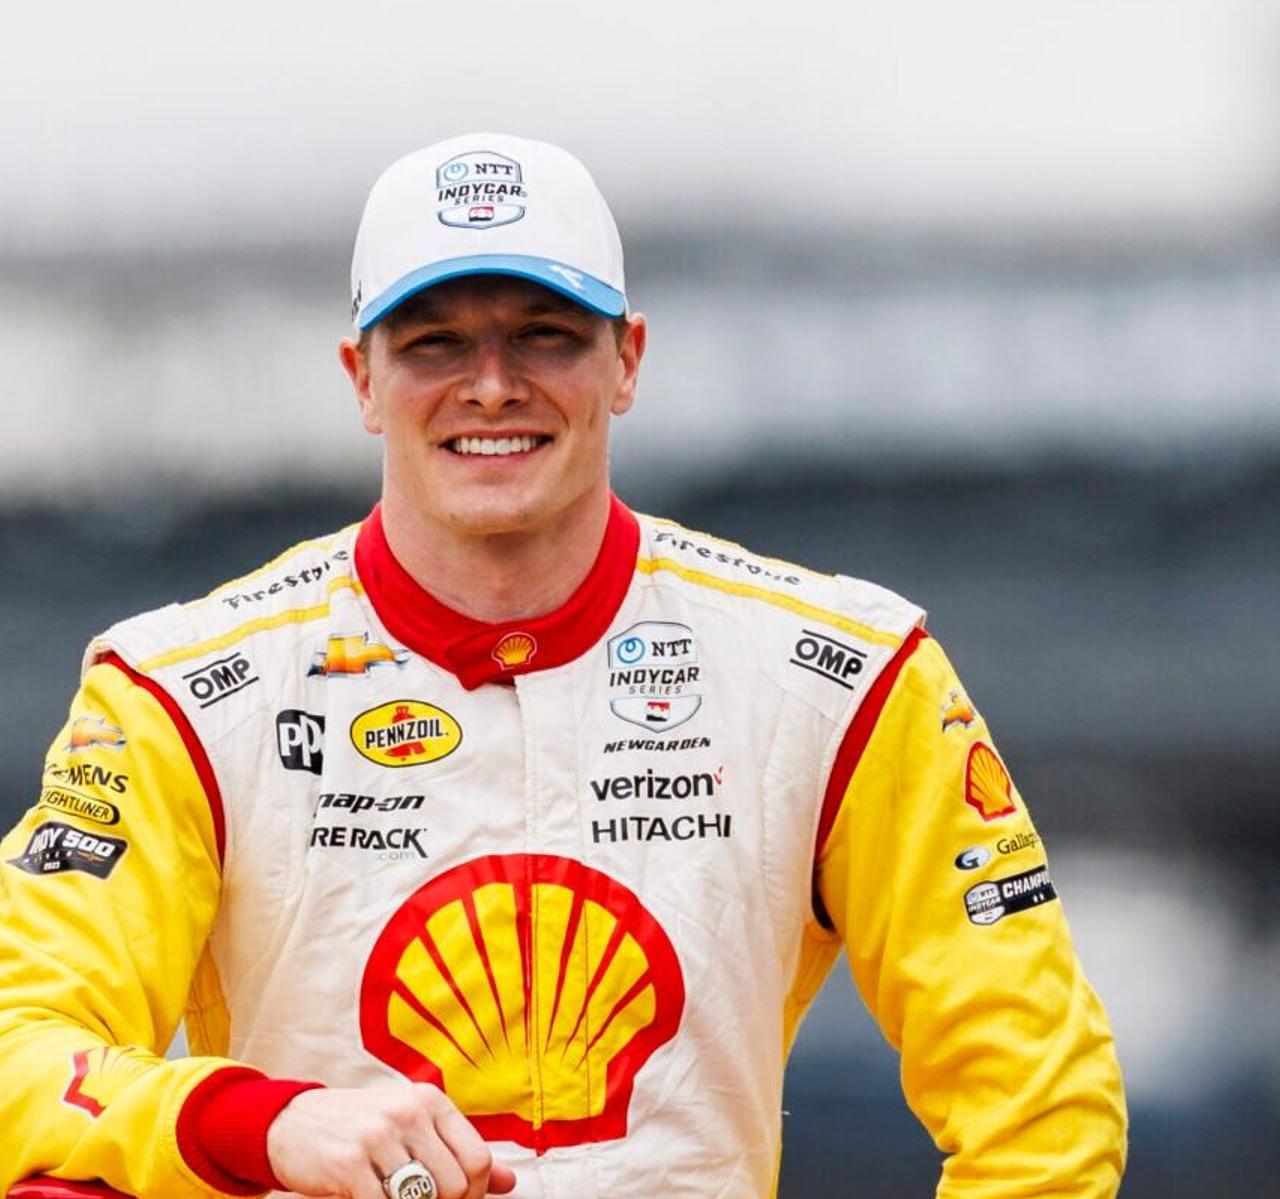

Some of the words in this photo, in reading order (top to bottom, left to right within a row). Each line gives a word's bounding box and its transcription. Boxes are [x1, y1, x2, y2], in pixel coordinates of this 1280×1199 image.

[475, 163, 515, 176] NTT
[437, 182, 522, 202] INDYCAR
[454, 194, 505, 206] SERIES
[651, 639, 692, 657] NTT
[795, 637, 864, 679] OMP
[189, 658, 251, 700] OMP
[609, 667, 700, 687] INDYCAR
[629, 685, 682, 695] SERIES
[365, 719, 444, 749] PENNZOIL
[604, 737, 711, 754] NEWGARDEN
[590, 769, 714, 801] verizon
[316, 793, 425, 817] nap-on
[592, 814, 732, 844] HITACHI
[62, 830, 116, 858] 500
[349, 827, 429, 859] RACK
